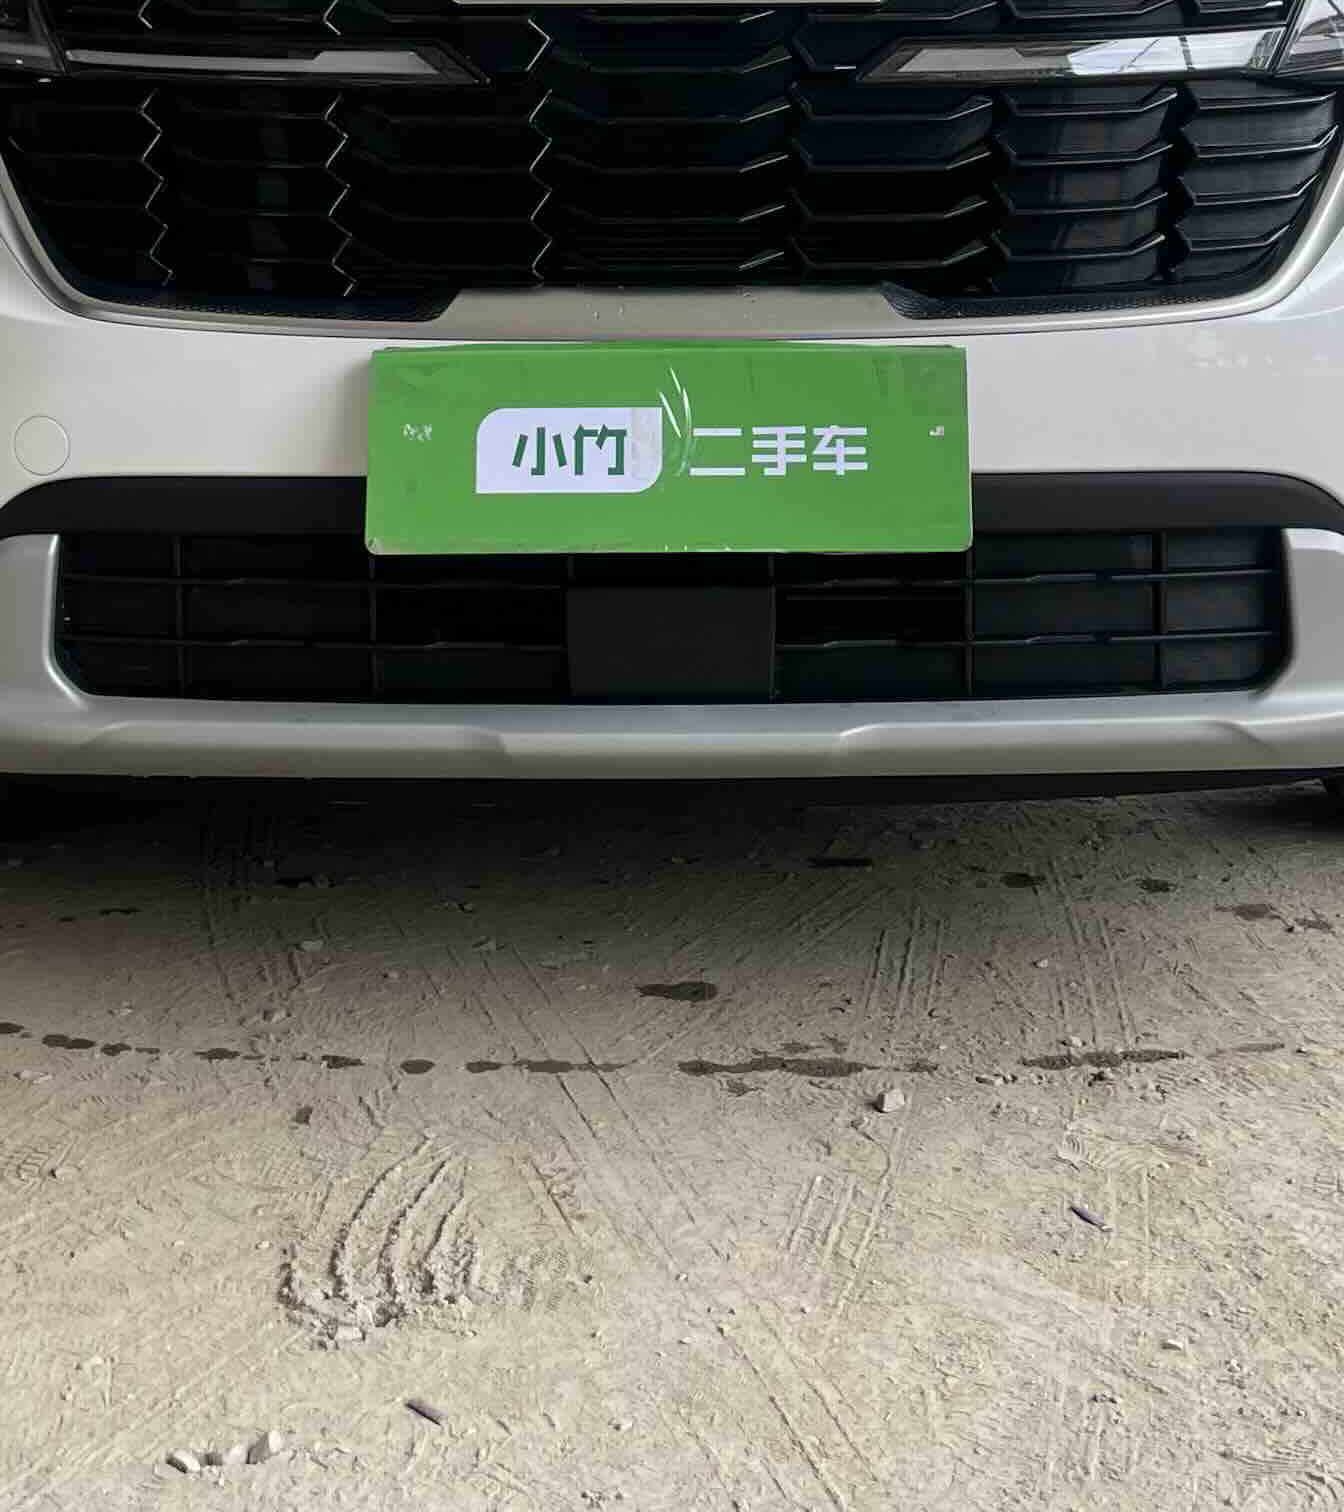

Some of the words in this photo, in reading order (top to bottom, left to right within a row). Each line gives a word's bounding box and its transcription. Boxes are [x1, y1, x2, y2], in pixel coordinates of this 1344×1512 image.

[511, 423, 628, 477] 小竹
[688, 424, 869, 477] 二手车
